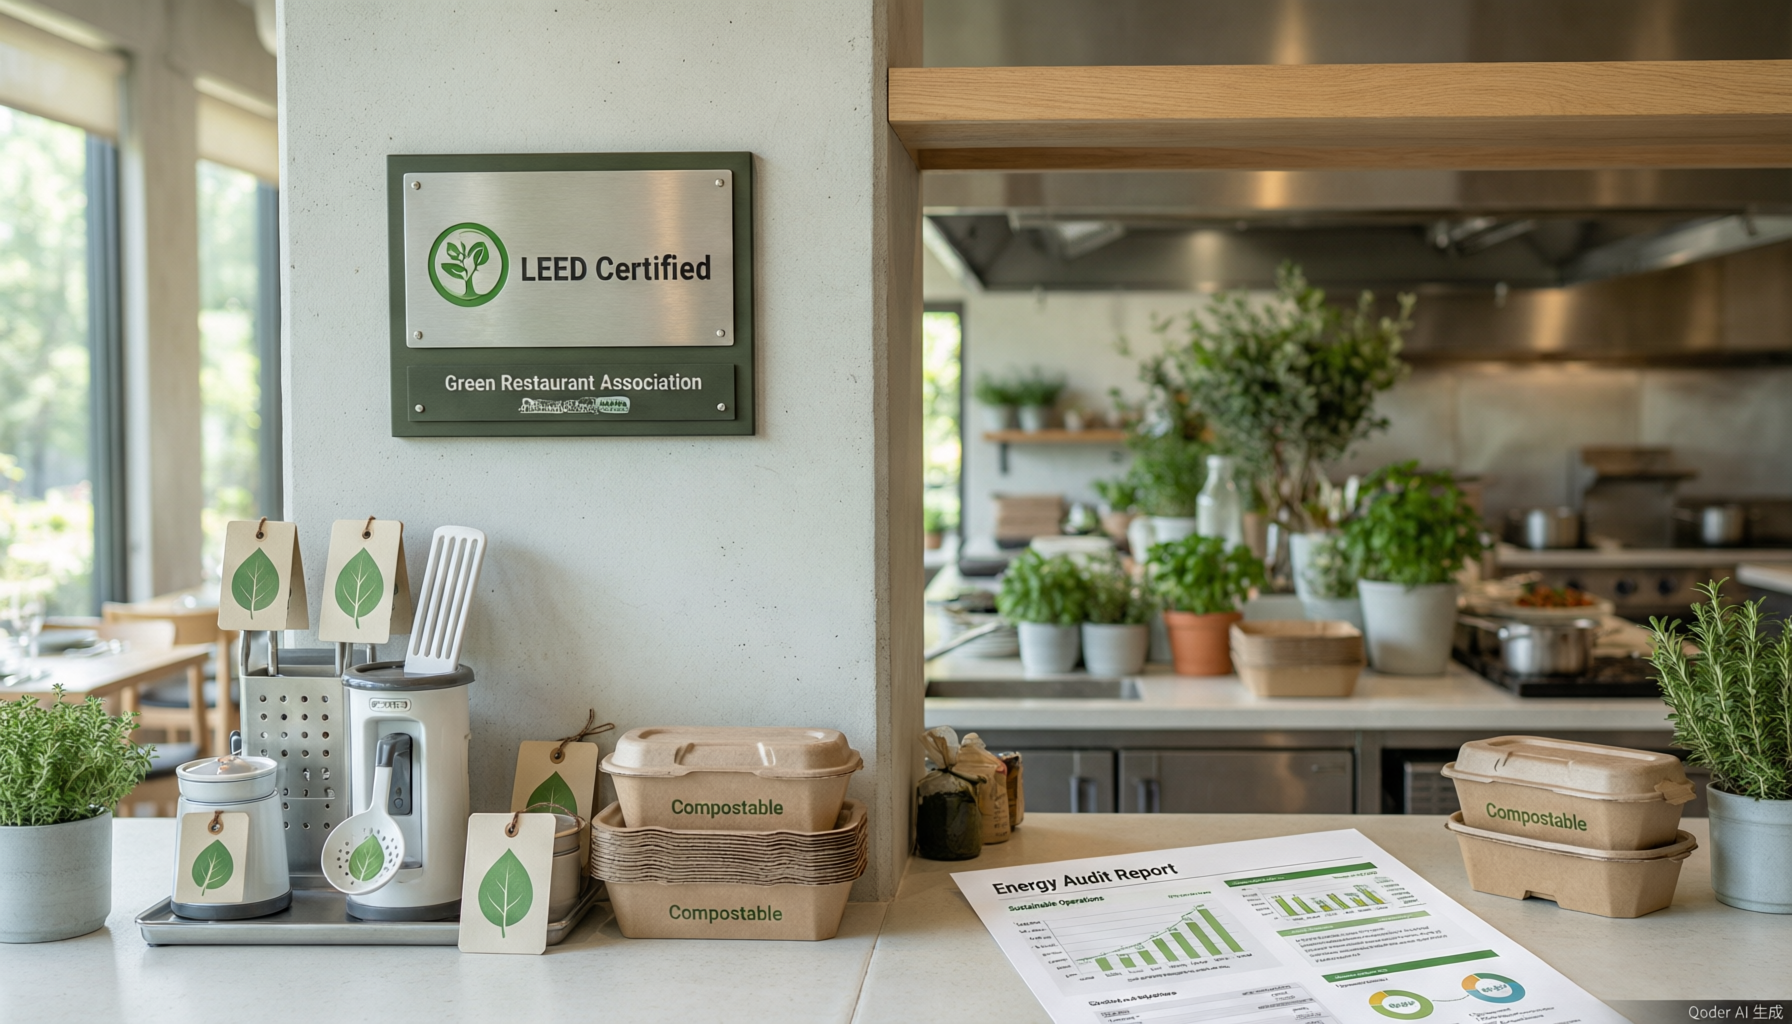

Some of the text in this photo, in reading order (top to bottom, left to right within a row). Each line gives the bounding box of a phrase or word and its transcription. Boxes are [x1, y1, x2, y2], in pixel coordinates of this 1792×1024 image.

[521, 254, 712, 282] LEED Certified
[445, 373, 702, 391] Green Restaurant Association
[671, 798, 784, 818] Compostable
[1486, 802, 1588, 832] Compostable
[992, 863, 1178, 895] Energy Audit Report
[1008, 894, 1105, 912] Sustainable Operations
[668, 904, 783, 924] Compostable
